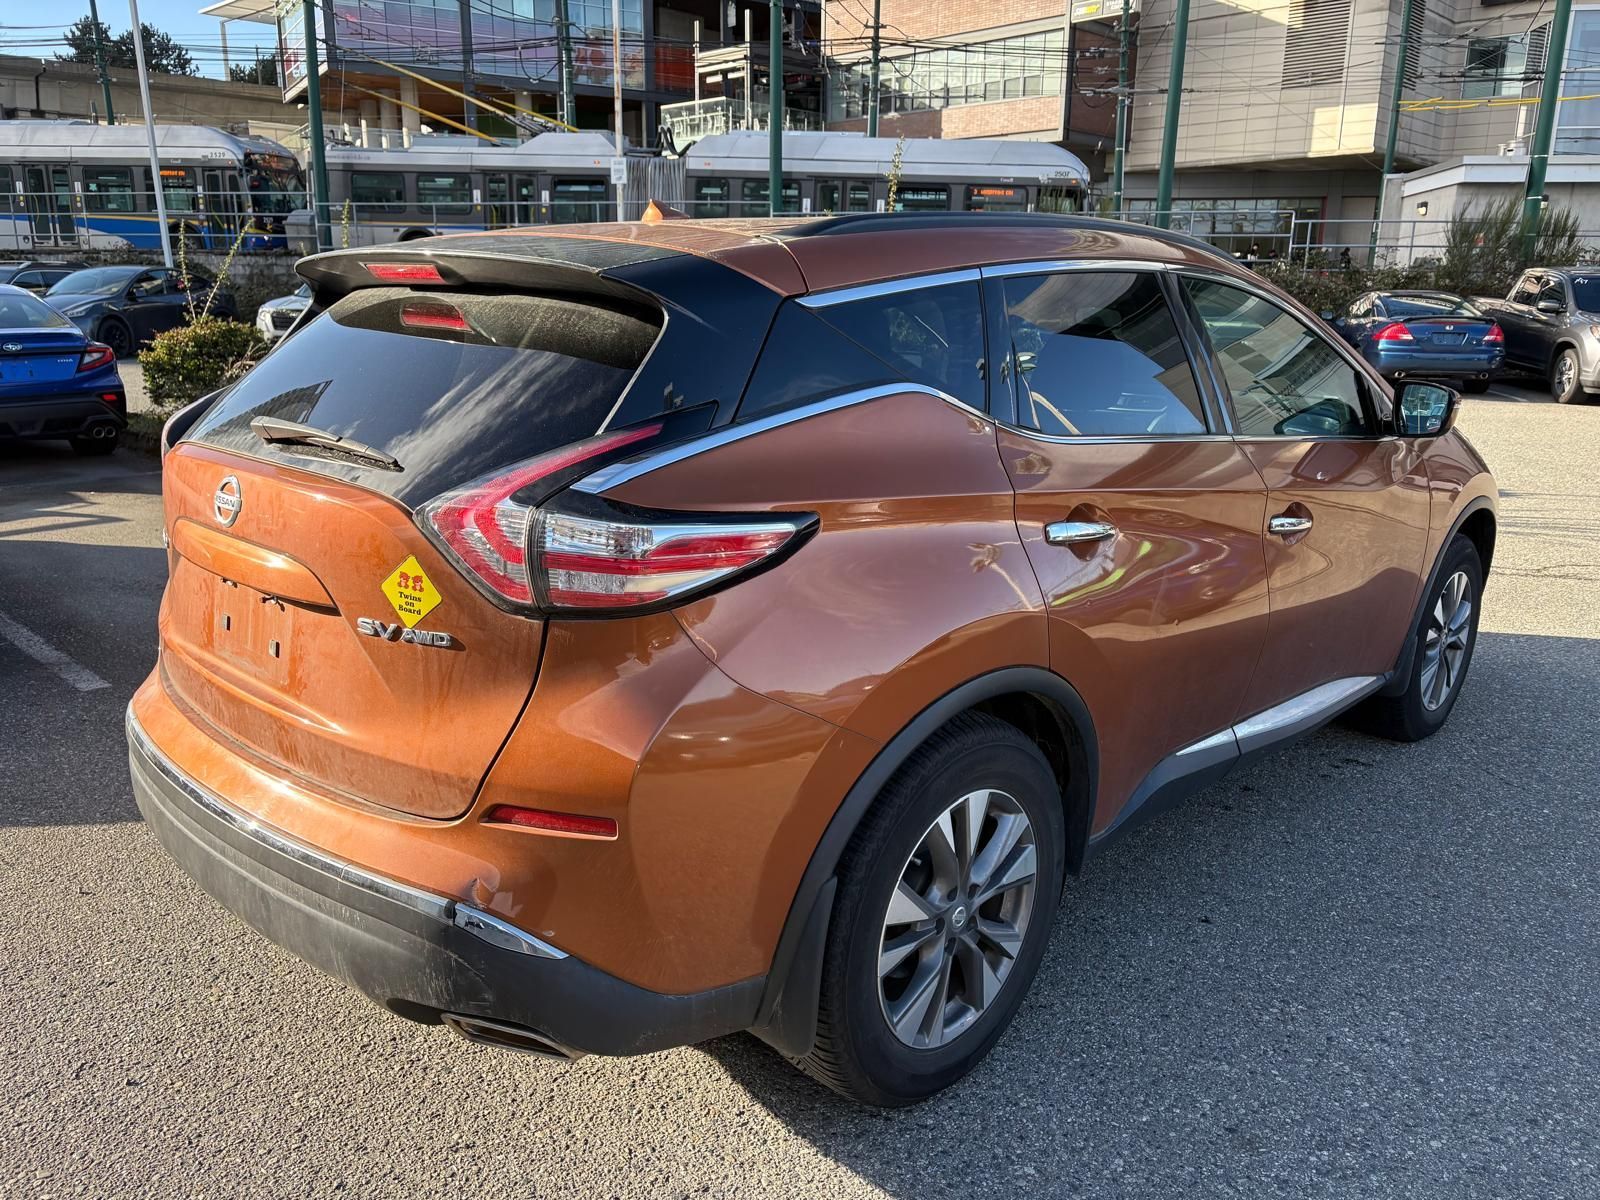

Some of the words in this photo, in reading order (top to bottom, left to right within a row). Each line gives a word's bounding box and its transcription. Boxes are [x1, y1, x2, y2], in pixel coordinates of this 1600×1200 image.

[398, 591, 422, 602] Twins
[398, 604, 422, 615] Board
[357, 617, 398, 641] SV
[400, 628, 451, 647] AWD
